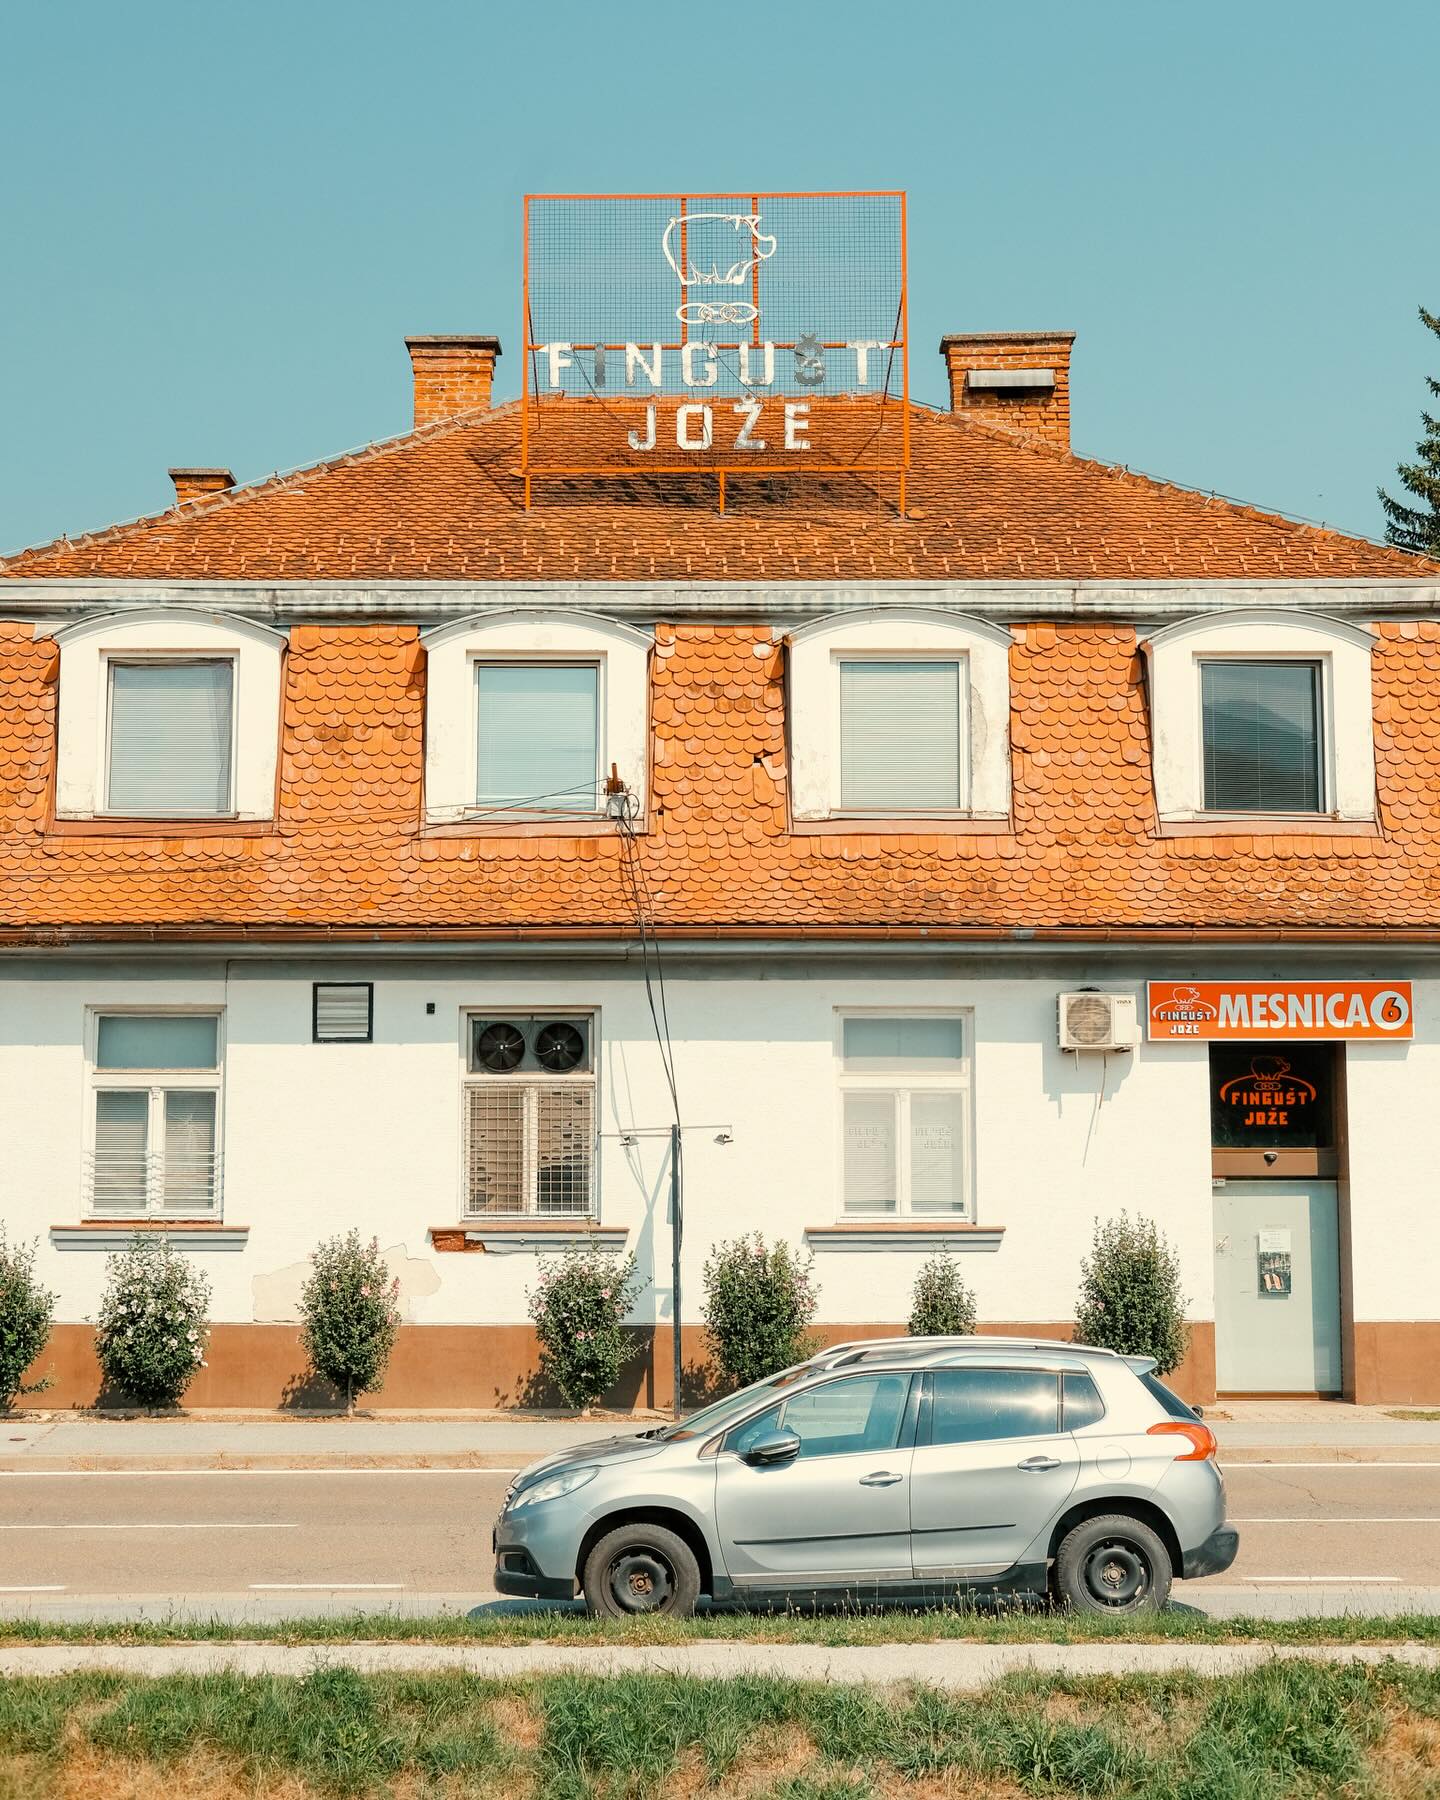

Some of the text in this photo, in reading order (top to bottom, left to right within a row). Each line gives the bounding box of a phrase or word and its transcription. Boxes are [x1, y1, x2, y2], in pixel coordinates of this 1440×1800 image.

[539, 333, 889, 387] FINGUŠT
[627, 394, 811, 451] JOŽE
[1159, 1007, 1212, 1021] FINGUŠT
[1218, 993, 1402, 1028] MESNICA 6
[1169, 1022, 1200, 1035] JOŽE
[1231, 1087, 1308, 1105] FINGUŠT
[1244, 1107, 1289, 1126] JOŽE
